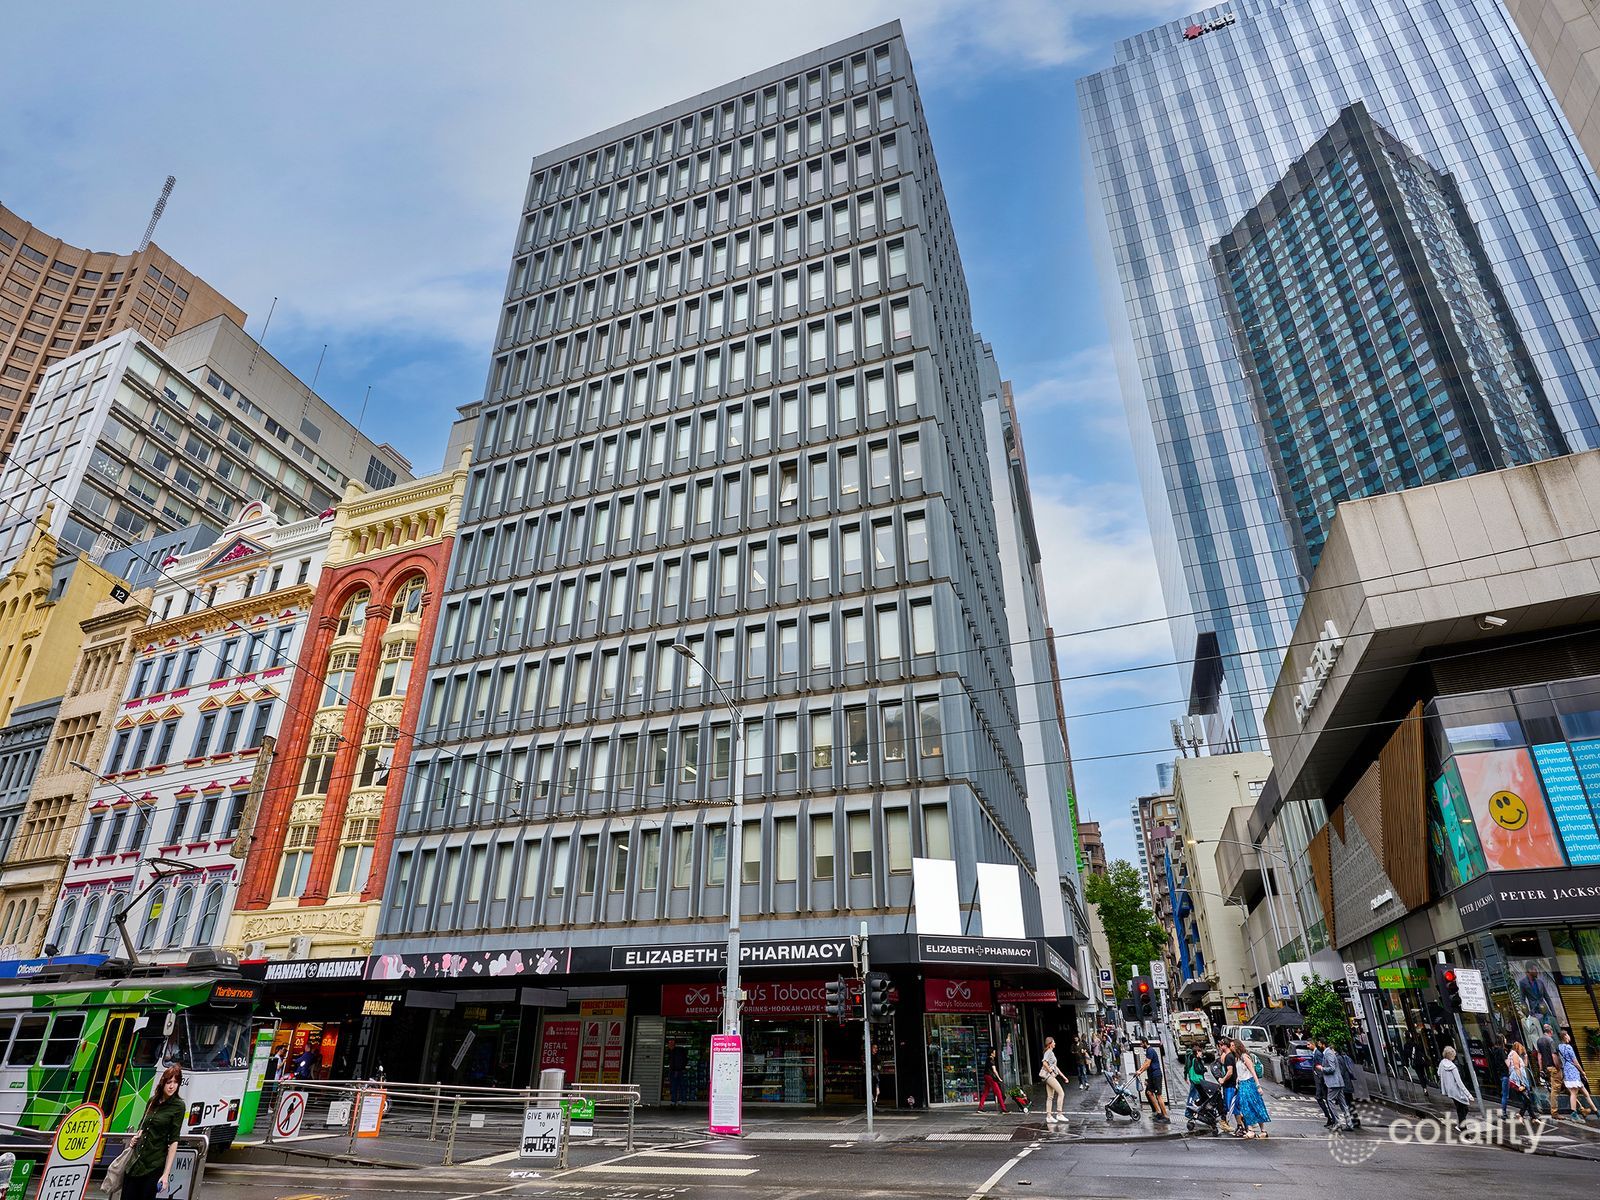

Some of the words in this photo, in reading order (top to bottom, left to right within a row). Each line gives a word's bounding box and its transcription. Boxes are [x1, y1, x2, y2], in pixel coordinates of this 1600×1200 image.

[115, 590, 126, 601] 12
[1500, 889, 1547, 901] PETER
[1460, 903, 1475, 916] PETER
[1474, 894, 1495, 911] JACKSON
[625, 948, 718, 965] ELIZABETH
[740, 943, 846, 961] PHARMACY
[926, 944, 975, 954] ELIZABETH
[984, 947, 1032, 957] PHARMACY
[265, 963, 310, 980] MANIAX
[316, 960, 365, 978] MANIAX
[1102, 972, 1109, 980] P
[362, 1000, 394, 1011] MANIAX
[543, 1042, 568, 1050] RETAIL
[543, 1049, 557, 1057] FOR
[232, 1057, 248, 1067] 134
[542, 1056, 565, 1064] LEASE
[527, 1112, 542, 1120] GIVE
[546, 1111, 561, 1120] WAY
[65, 1120, 99, 1135] SAFETY
[65, 1137, 88, 1150] ZONE
[176, 1158, 193, 1170] WAY
[50, 1173, 81, 1188] KEEP
[47, 1189, 75, 1200] LEFT
